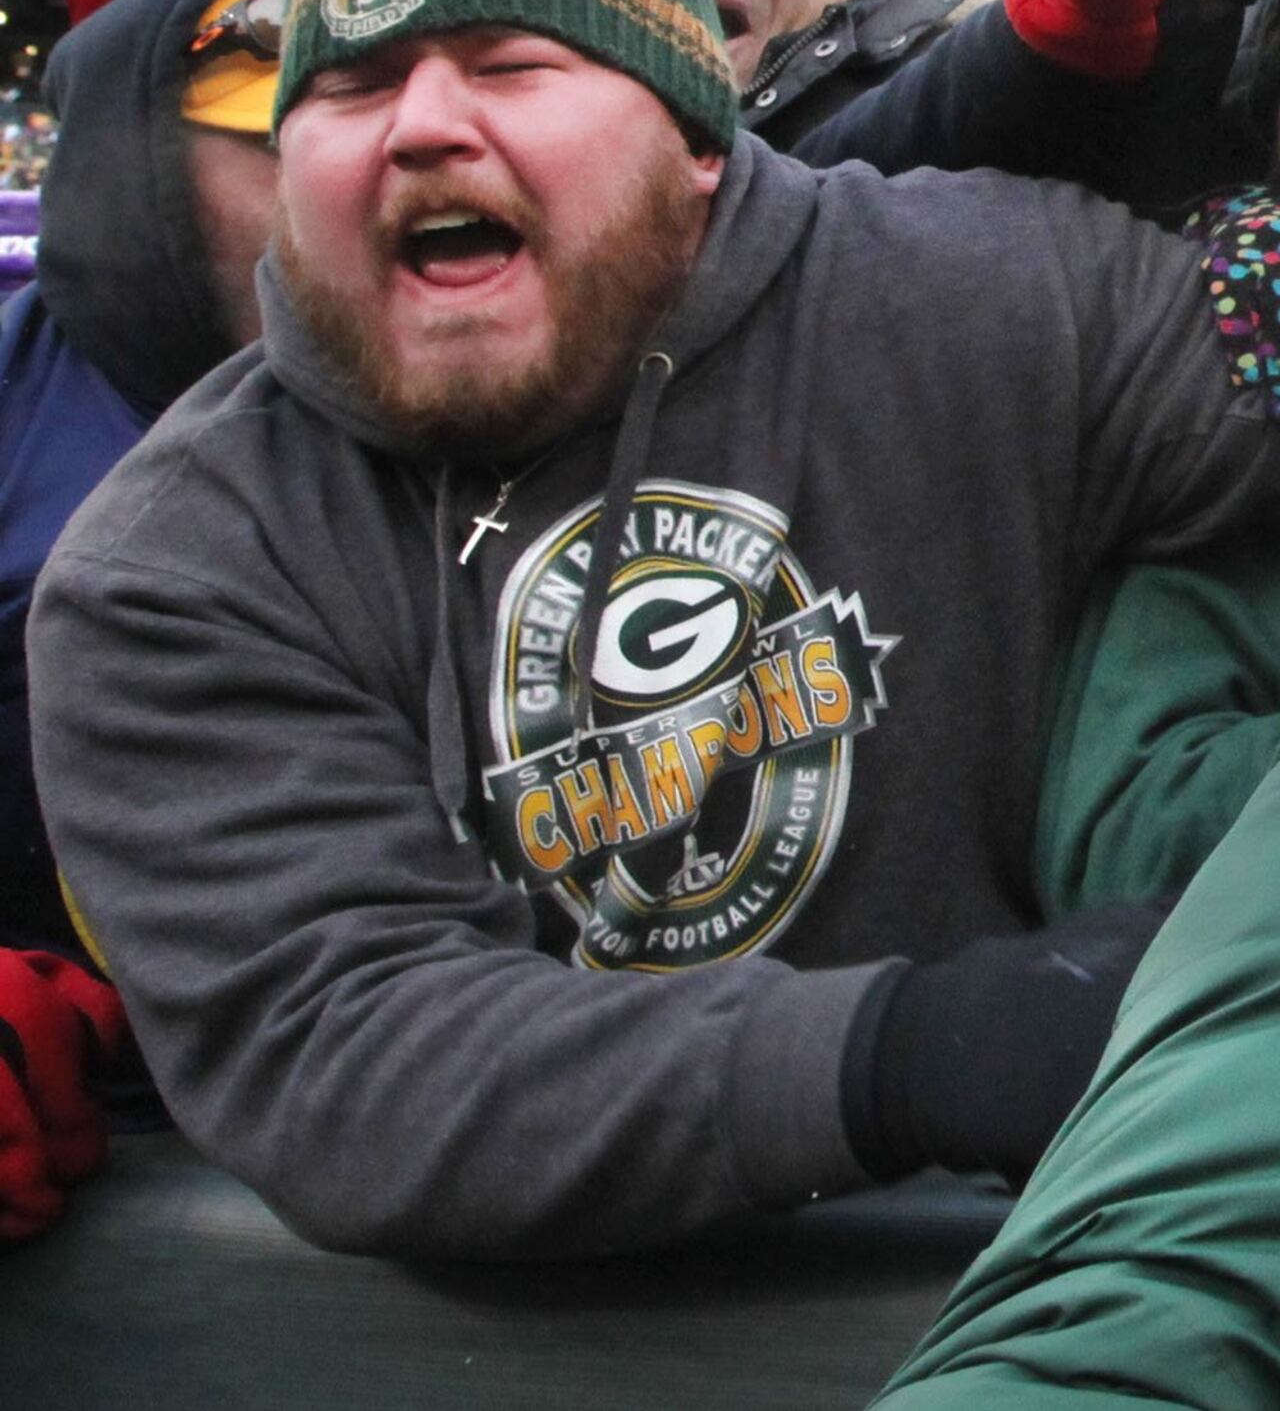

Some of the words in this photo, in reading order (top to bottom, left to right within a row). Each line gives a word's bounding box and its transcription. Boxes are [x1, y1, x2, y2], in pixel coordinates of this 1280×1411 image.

[516, 567, 587, 714] GREEN
[653, 507, 782, 595] PACKE
[591, 577, 740, 695] G
[721, 625, 816, 706] BWL
[515, 635, 852, 874] CHAMPONS
[645, 883, 775, 951] FOOTBALL
[767, 768, 820, 875] LEAGUE
